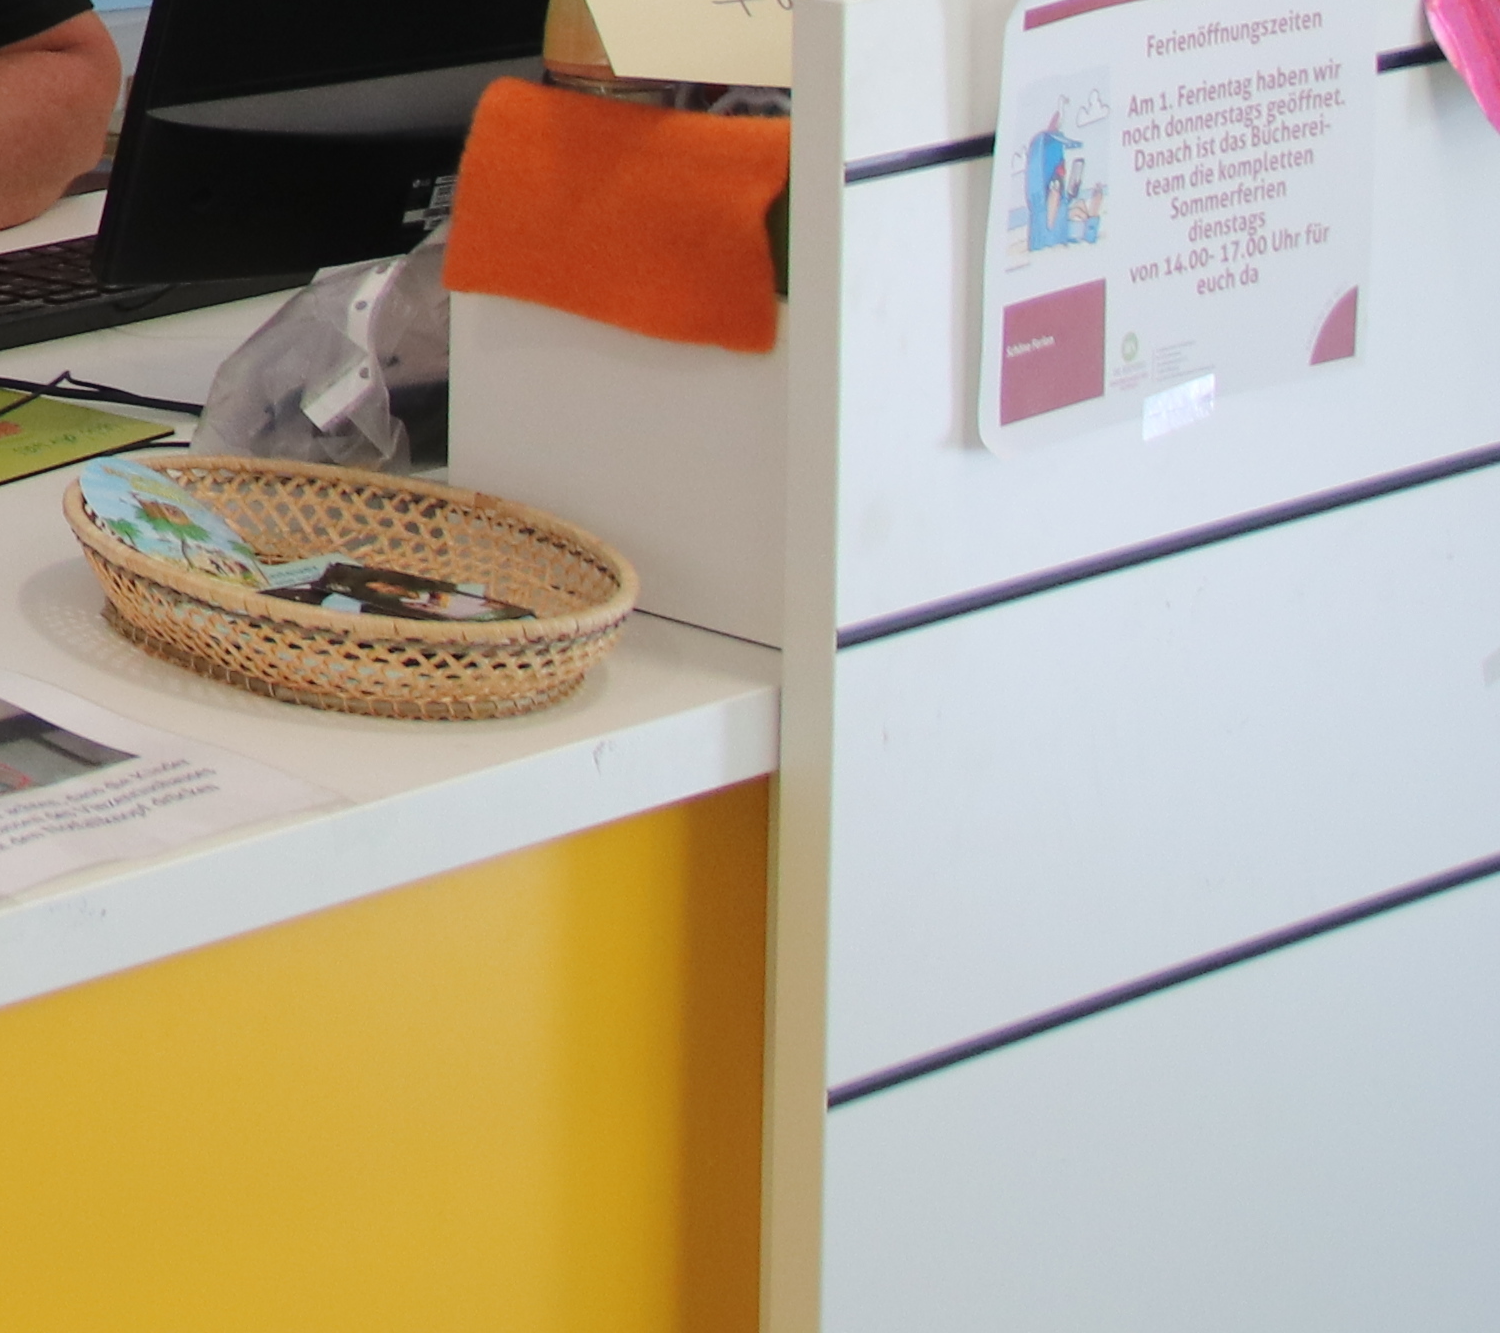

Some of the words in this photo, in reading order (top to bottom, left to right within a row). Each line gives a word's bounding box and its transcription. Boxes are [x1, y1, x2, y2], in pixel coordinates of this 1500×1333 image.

[1146, 10, 1323, 57] Ferienöffnungszeiten
[1128, 94, 1154, 117] Am
[1159, 92, 1173, 111] 1.
[1177, 77, 1251, 108] Ferientag
[1256, 67, 1309, 92] haben
[1314, 58, 1342, 82] wir
[1122, 122, 1160, 147] noch
[1165, 102, 1262, 137] donnerstags
[1267, 87, 1346, 126] geöffnet.
[1134, 140, 1192, 172] Danach
[1197, 136, 1216, 159] ist
[1220, 130, 1246, 154] das
[1251, 114, 1331, 148] Bücherei-
[1146, 173, 1185, 197] team
[1190, 163, 1214, 187] die
[1218, 148, 1314, 181] kompletten
[1170, 179, 1287, 220] Sommerferien
[1188, 211, 1266, 243] dienstags
[1130, 262, 1159, 284] von
[1164, 247, 1215, 277] 14.00-
[1220, 234, 1268, 263] 17.00
[1271, 227, 1301, 253] Uhr
[1305, 221, 1330, 245] für
[1197, 267, 1235, 295] euch
[1240, 263, 1260, 286] da
